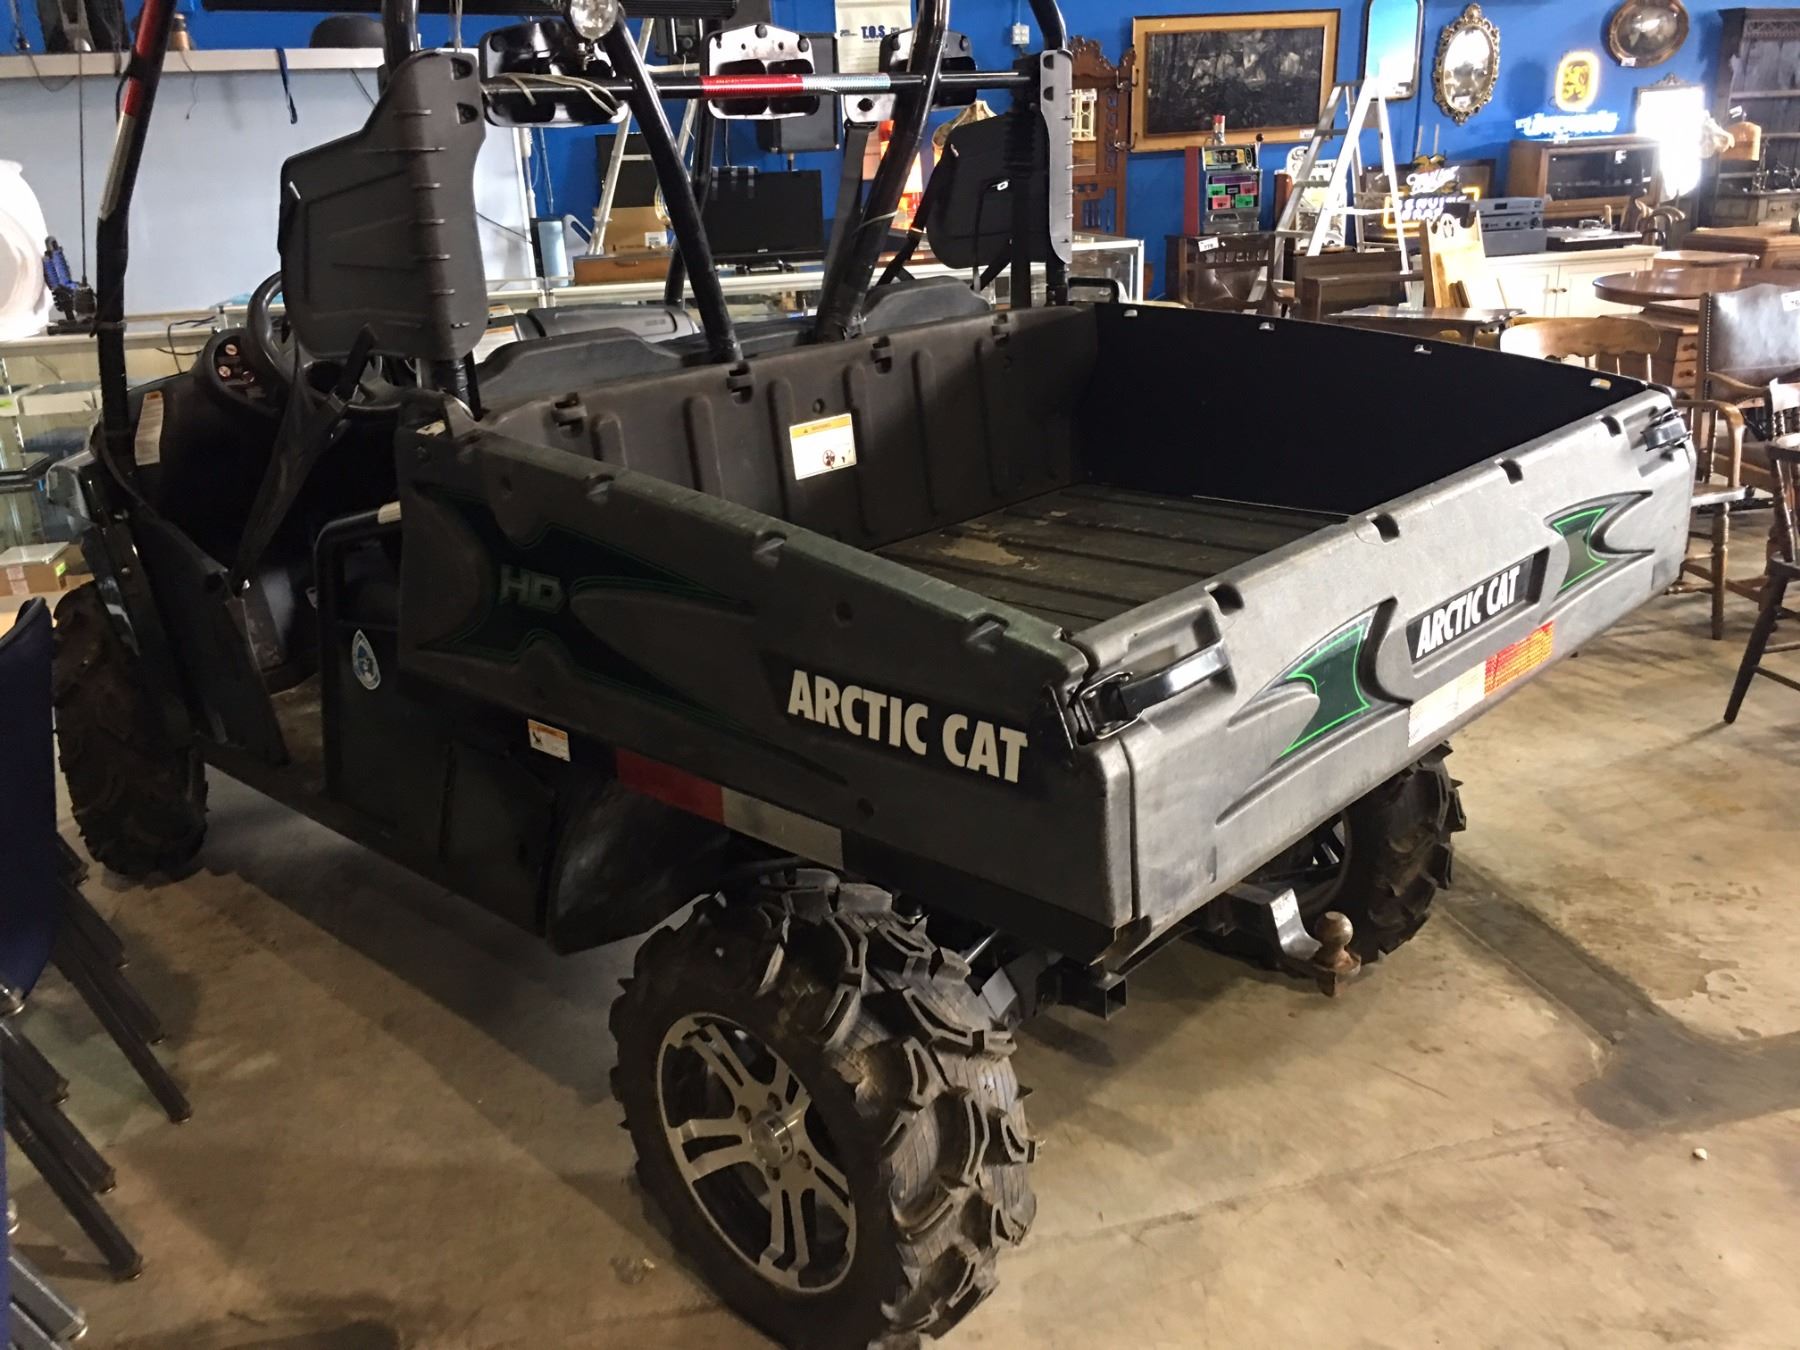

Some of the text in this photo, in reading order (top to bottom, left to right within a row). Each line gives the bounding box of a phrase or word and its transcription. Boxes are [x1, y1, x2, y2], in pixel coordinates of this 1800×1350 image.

[500, 564, 561, 614] HD
[1415, 565, 1521, 659] ARCTIC CAT
[787, 669, 1029, 783] ARCTIC CAT
